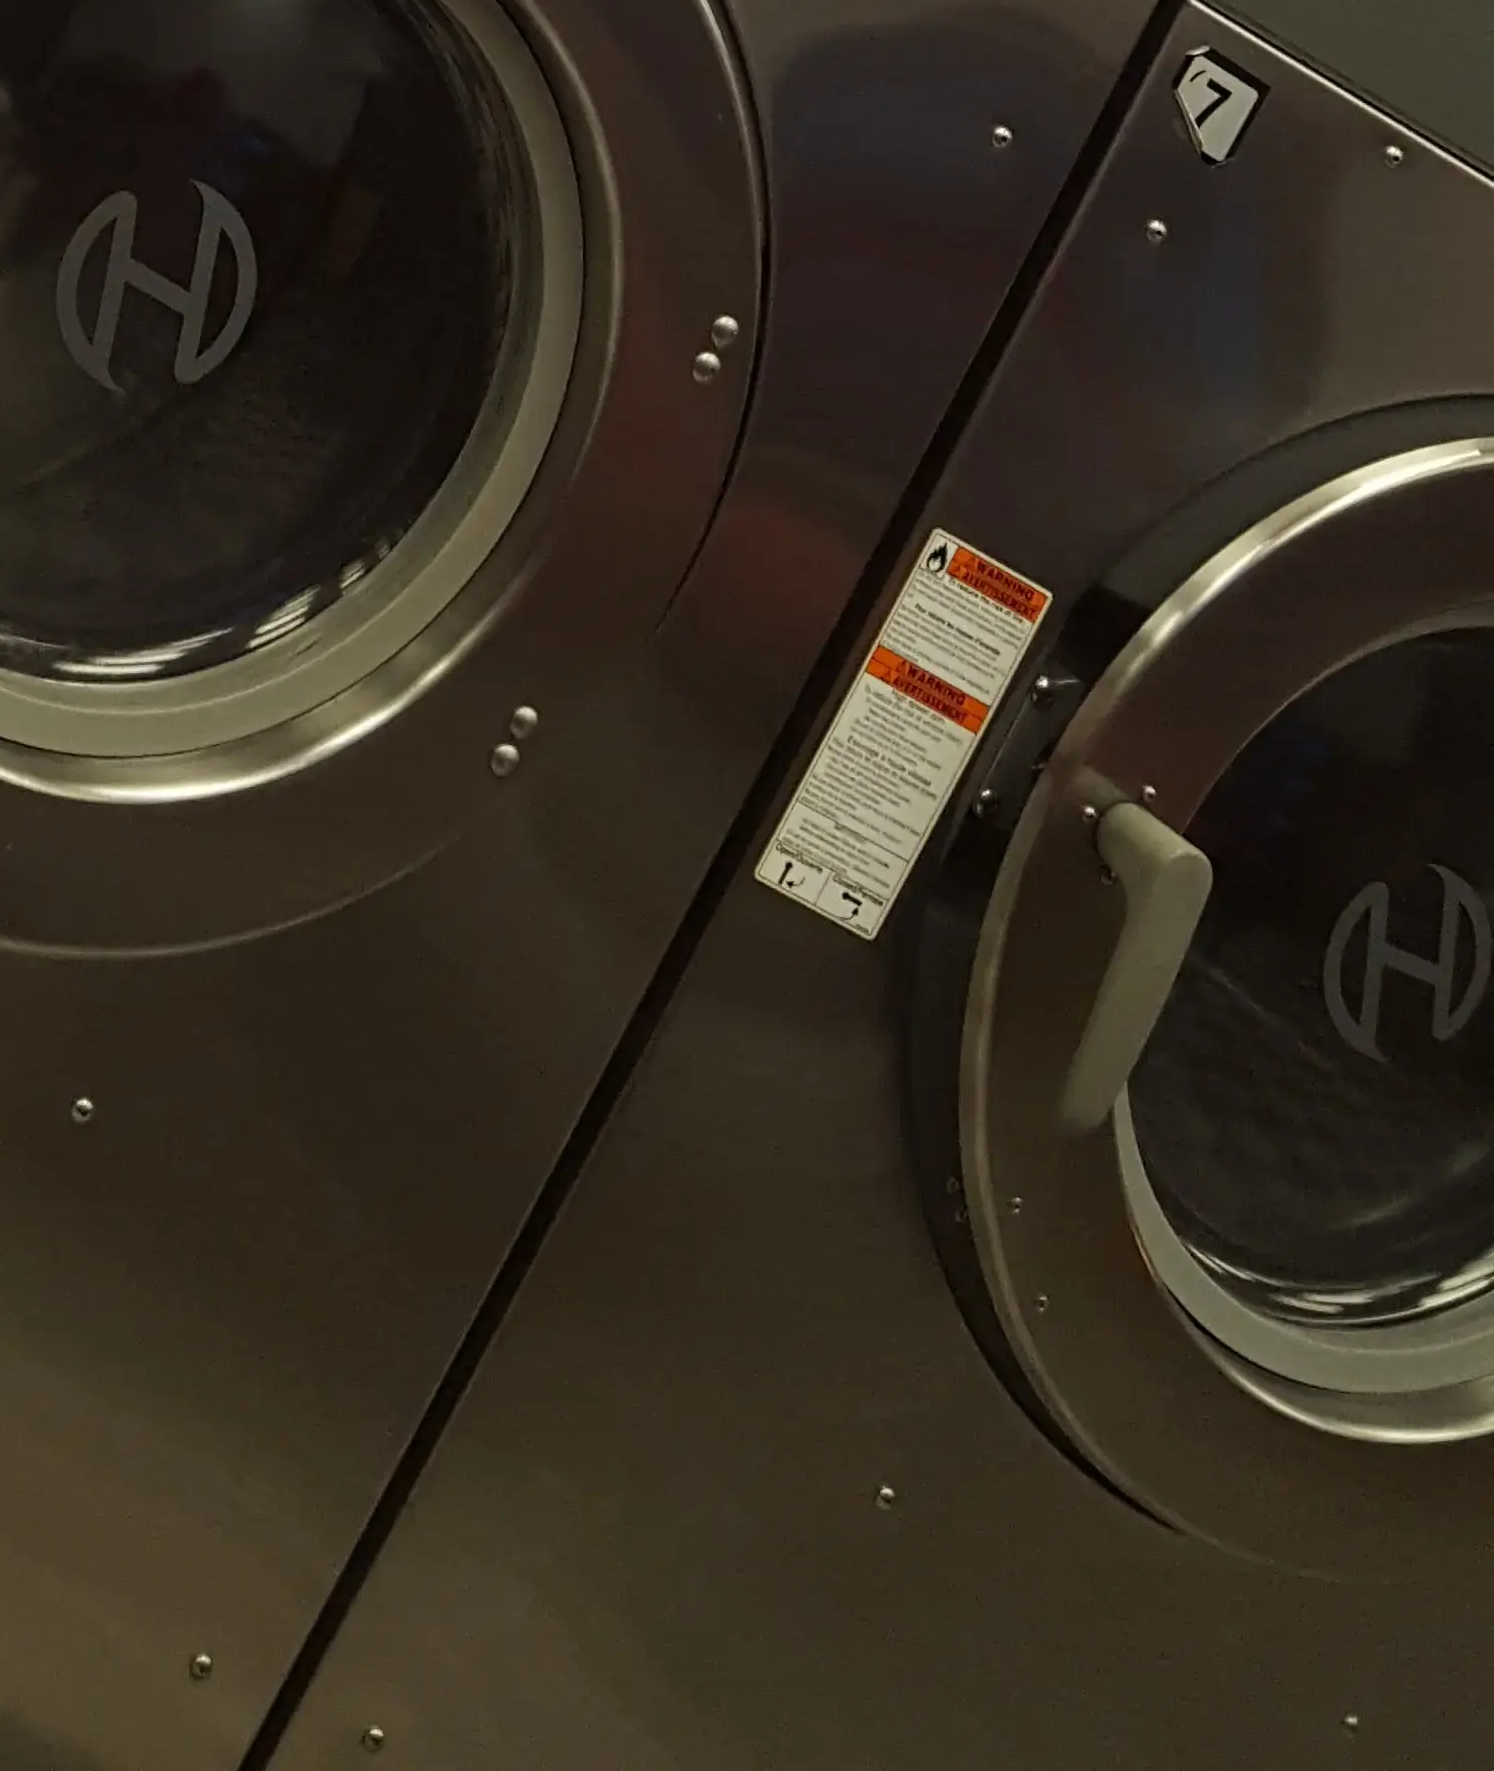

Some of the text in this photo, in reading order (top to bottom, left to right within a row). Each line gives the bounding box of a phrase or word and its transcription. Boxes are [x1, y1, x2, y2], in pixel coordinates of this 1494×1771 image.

[1195, 78, 1232, 129] 7
[974, 561, 1035, 601] WARNING
[905, 666, 966, 705] WARNING
